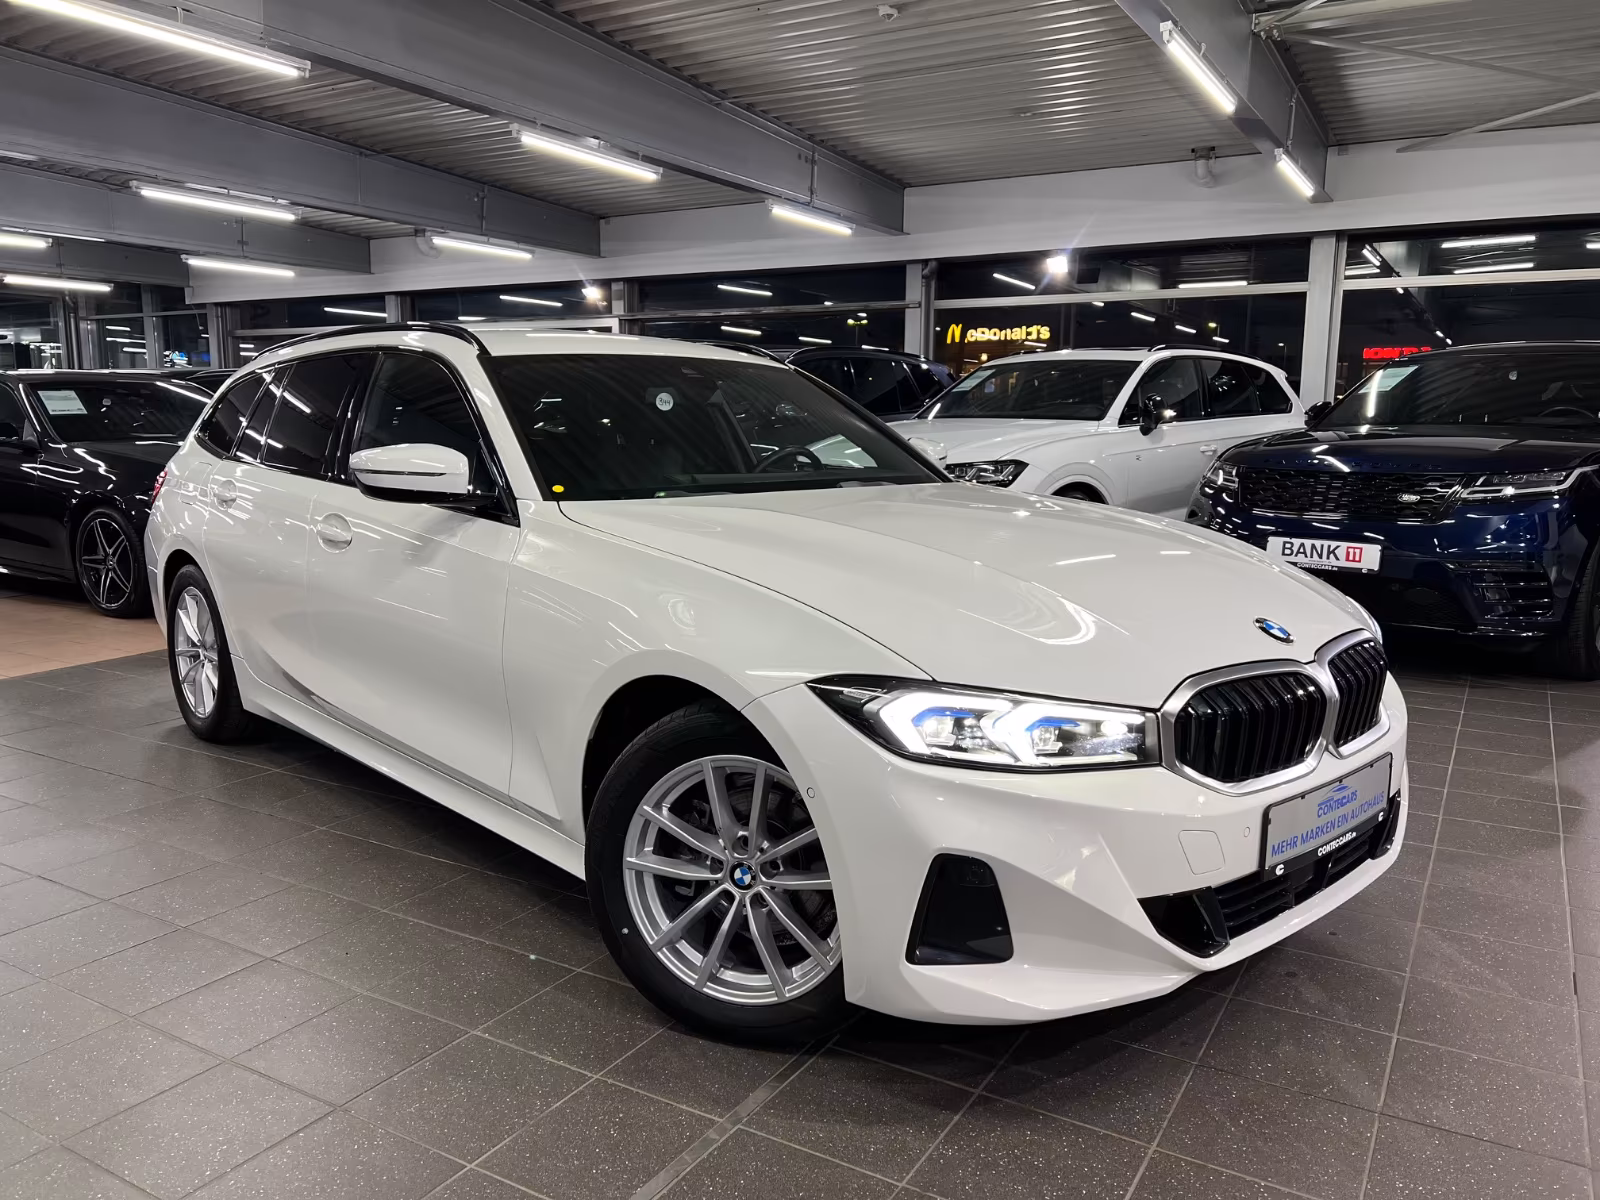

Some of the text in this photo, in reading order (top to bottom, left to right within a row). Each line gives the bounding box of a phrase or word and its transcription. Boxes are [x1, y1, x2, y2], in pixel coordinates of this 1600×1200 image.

[1281, 541, 1341, 561] BANK
[1271, 790, 1385, 858] MEHR MARKEN EIN AUTOHAUS
